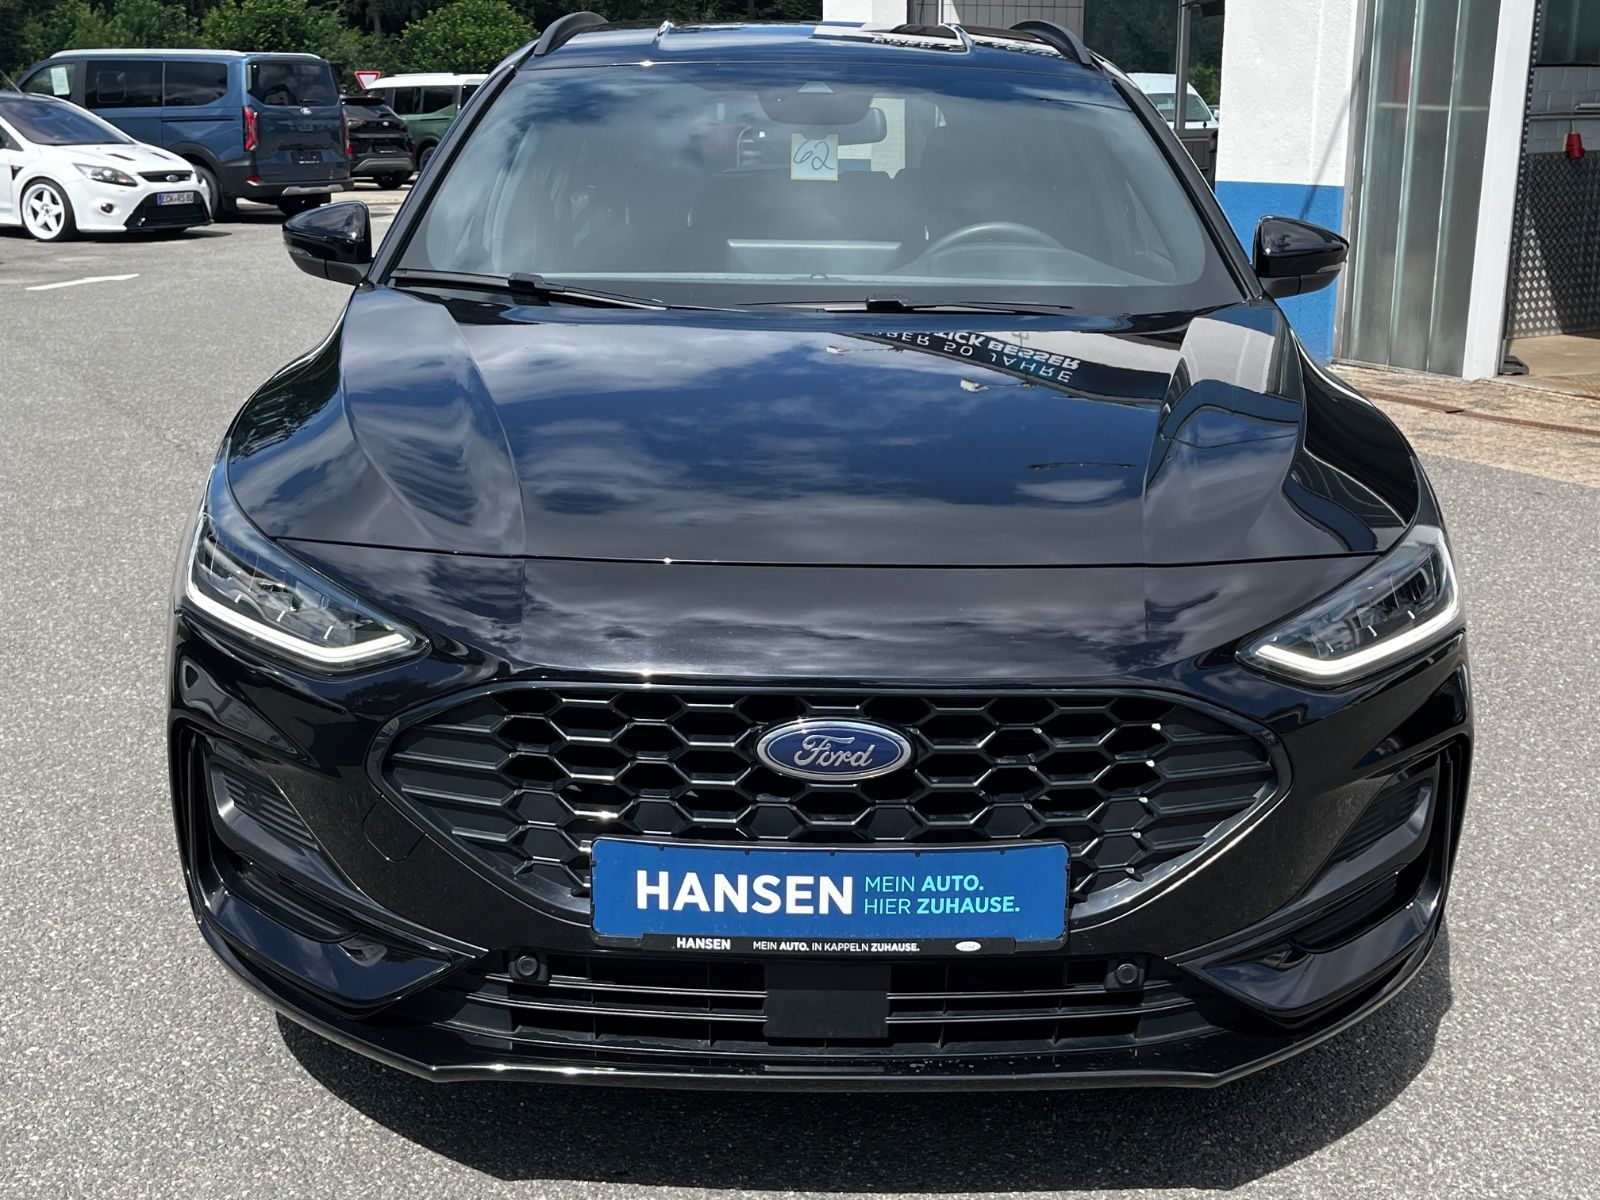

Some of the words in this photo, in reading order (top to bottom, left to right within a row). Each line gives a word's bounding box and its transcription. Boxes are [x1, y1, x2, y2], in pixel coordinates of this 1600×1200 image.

[793, 140, 836, 170] 62
[793, 734, 876, 767] Ford
[636, 869, 854, 915] HANSEN
[864, 875, 916, 893] MEIN
[920, 874, 985, 892] AUTO.
[864, 898, 912, 915] HIER
[916, 895, 1021, 915] ZUHAUSE.
[676, 936, 732, 950] HANSEN
[752, 940, 778, 950] MEIN
[779, 941, 810, 952] AUTO.
[811, 941, 823, 951] IN
[824, 942, 869, 952] KAPPELN
[870, 942, 920, 952] ZUHAUSE.
